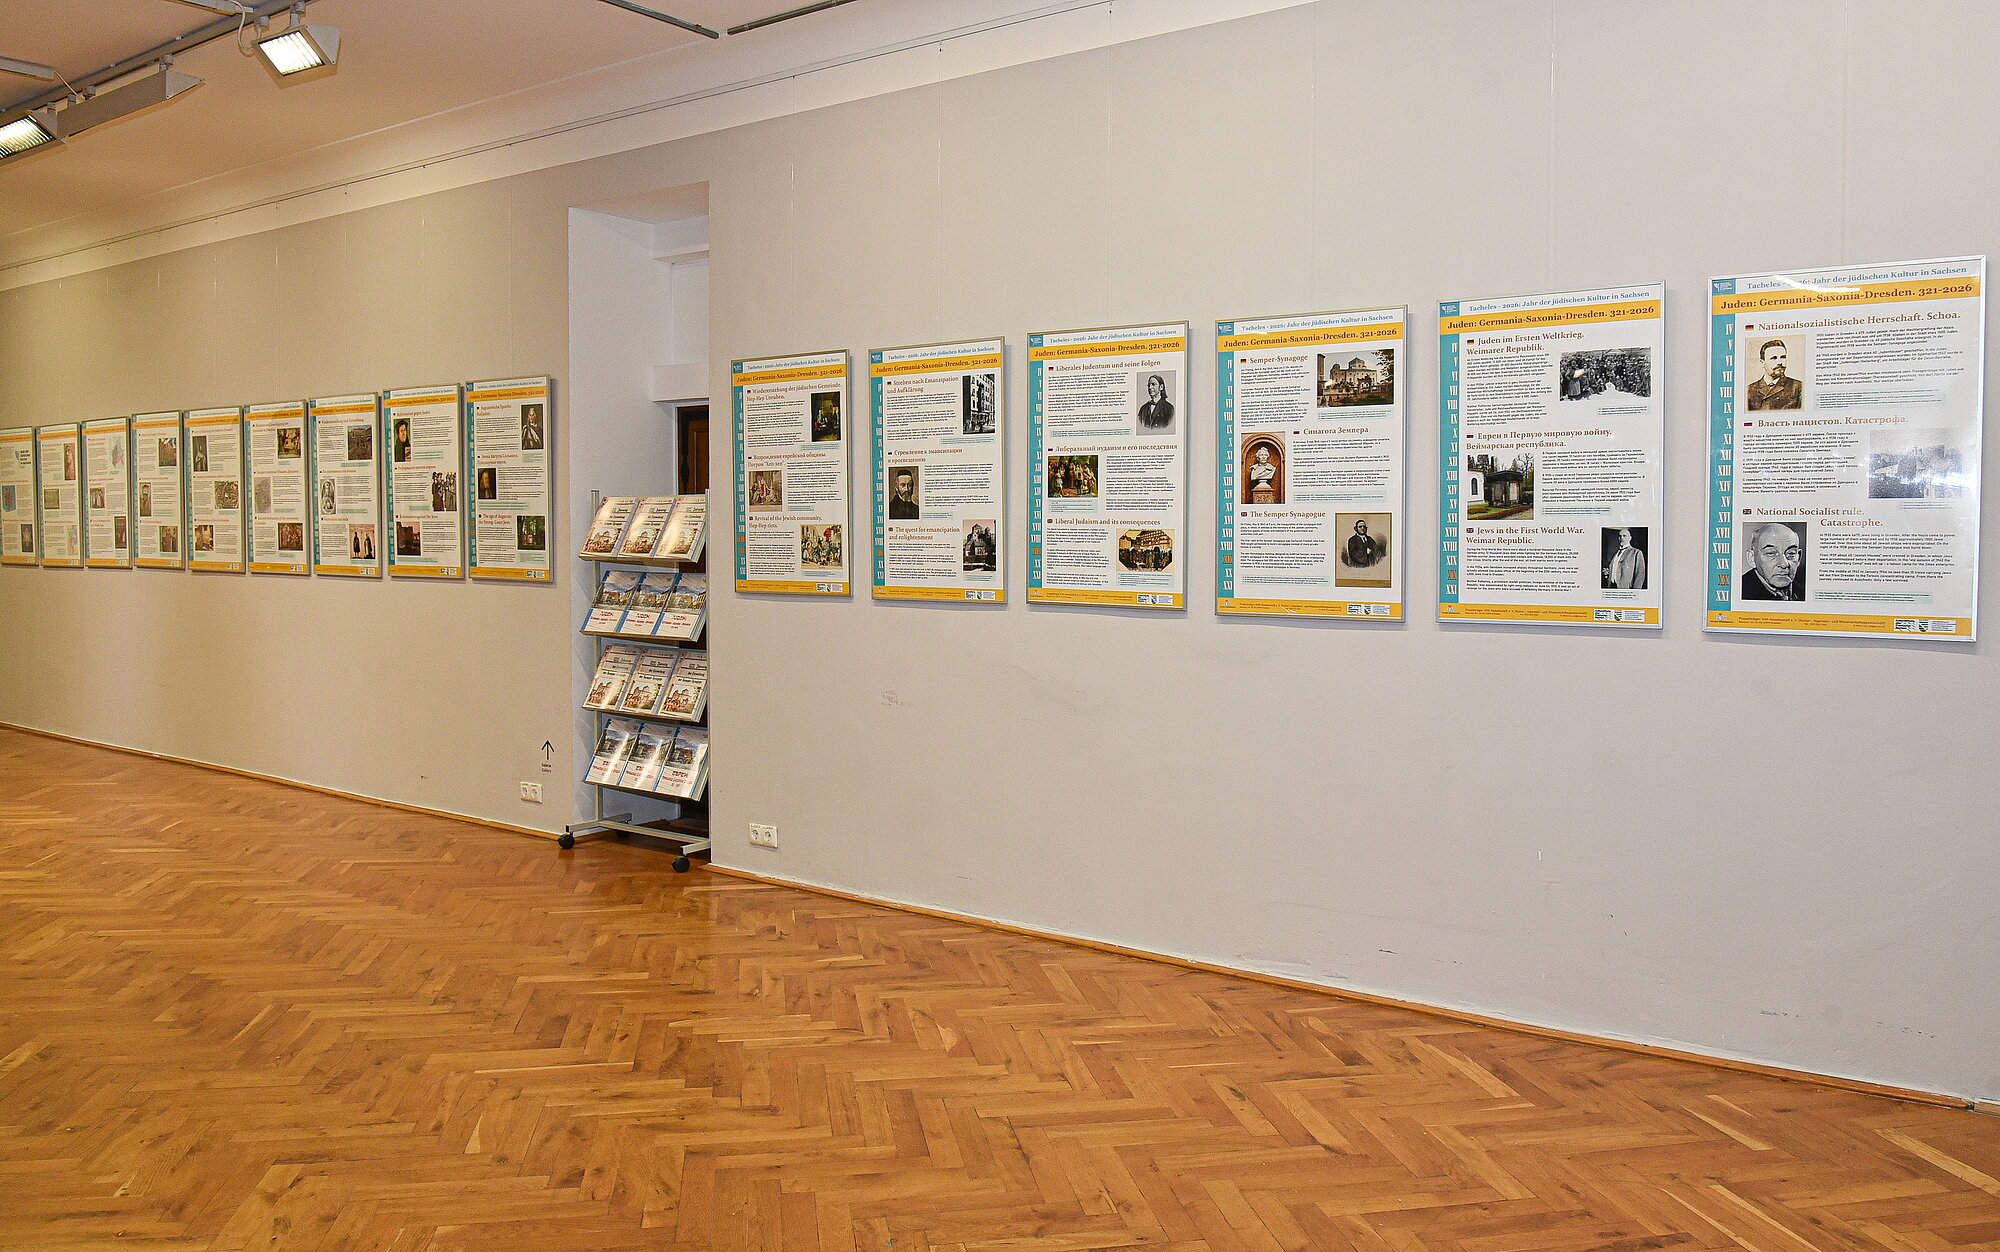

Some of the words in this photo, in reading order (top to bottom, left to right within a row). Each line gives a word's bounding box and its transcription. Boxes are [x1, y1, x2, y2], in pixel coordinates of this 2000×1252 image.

[1847, 273, 1888, 282] jüdischen
[1891, 270, 1918, 278] Kultur
[1931, 267, 1966, 275] Sachsen
[1551, 296, 1585, 305] jüdischen
[1720, 300, 1756, 309] Juden:
[1759, 289, 1915, 306] Germania-Saxonia-Dresden.
[1918, 283, 1971, 296] 321-2026
[1447, 320, 1476, 328] Juden:
[1479, 310, 1607, 326] Germania-Saxonia-Dresden.
[1610, 306, 1653, 317] 321-2026
[1758, 317, 1864, 330] Nationalsozialistische
[1867, 312, 1923, 323] Herrschaft.
[1926, 311, 1960, 320] Schoa.
[1726, 323, 1733, 334] IV
[1223, 339, 1248, 347] Juden:
[1250, 332, 1358, 345] Germania-Saxonia-Dresden.
[1360, 328, 1396, 338] 321-2026
[1477, 337, 1500, 346] Juden
[1542, 331, 1584, 339] Weltkrieg.
[1056, 344, 1147, 355] Germania-Saxonia-Dresden.
[1148, 341, 1179, 350] 321-2026
[1506, 344, 1544, 353] Republik.
[1728, 339, 1733, 350] V
[1082, 363, 1110, 371] Judentum
[1141, 359, 1160, 367] Folgen
[1249, 355, 1307, 364] Semper-Synagoge
[1725, 355, 1732, 366] VI
[1722, 371, 1732, 381] VII
[1719, 387, 1732, 397] VIII
[1724, 402, 1731, 413] IX
[1726, 417, 1731, 428] X
[1758, 419, 1790, 427] Власть
[1845, 416, 1907, 425] Катастрофа.
[1477, 432, 1501, 441] Евреи
[1510, 431, 1542, 439] Первую
[1544, 430, 1582, 438] мировую
[1584, 428, 1611, 436] войну.
[1723, 433, 1731, 444] XI
[1515, 440, 1566, 449] республика.
[1720, 449, 1731, 460] XII
[1717, 465, 1730, 476] XIII
[1718, 480, 1731, 491] XIV
[1721, 496, 1730, 507] XV
[1263, 510, 1288, 518] Semper
[1289, 510, 1325, 519] Synagogue
[1718, 511, 1730, 522] XVI
[1756, 507, 1796, 515] National
[1799, 507, 1838, 515] Socialist
[1820, 518, 1882, 528] Catastrophe.
[1477, 527, 1494, 535] Jews
[1715, 527, 1729, 538] XVII
[1497, 536, 1534, 545] Republic.
[1712, 542, 1729, 553] XVIII
[1716, 558, 1729, 569] XIX
[1717, 573, 1729, 586] XX
[1715, 590, 1728, 601] XXI
